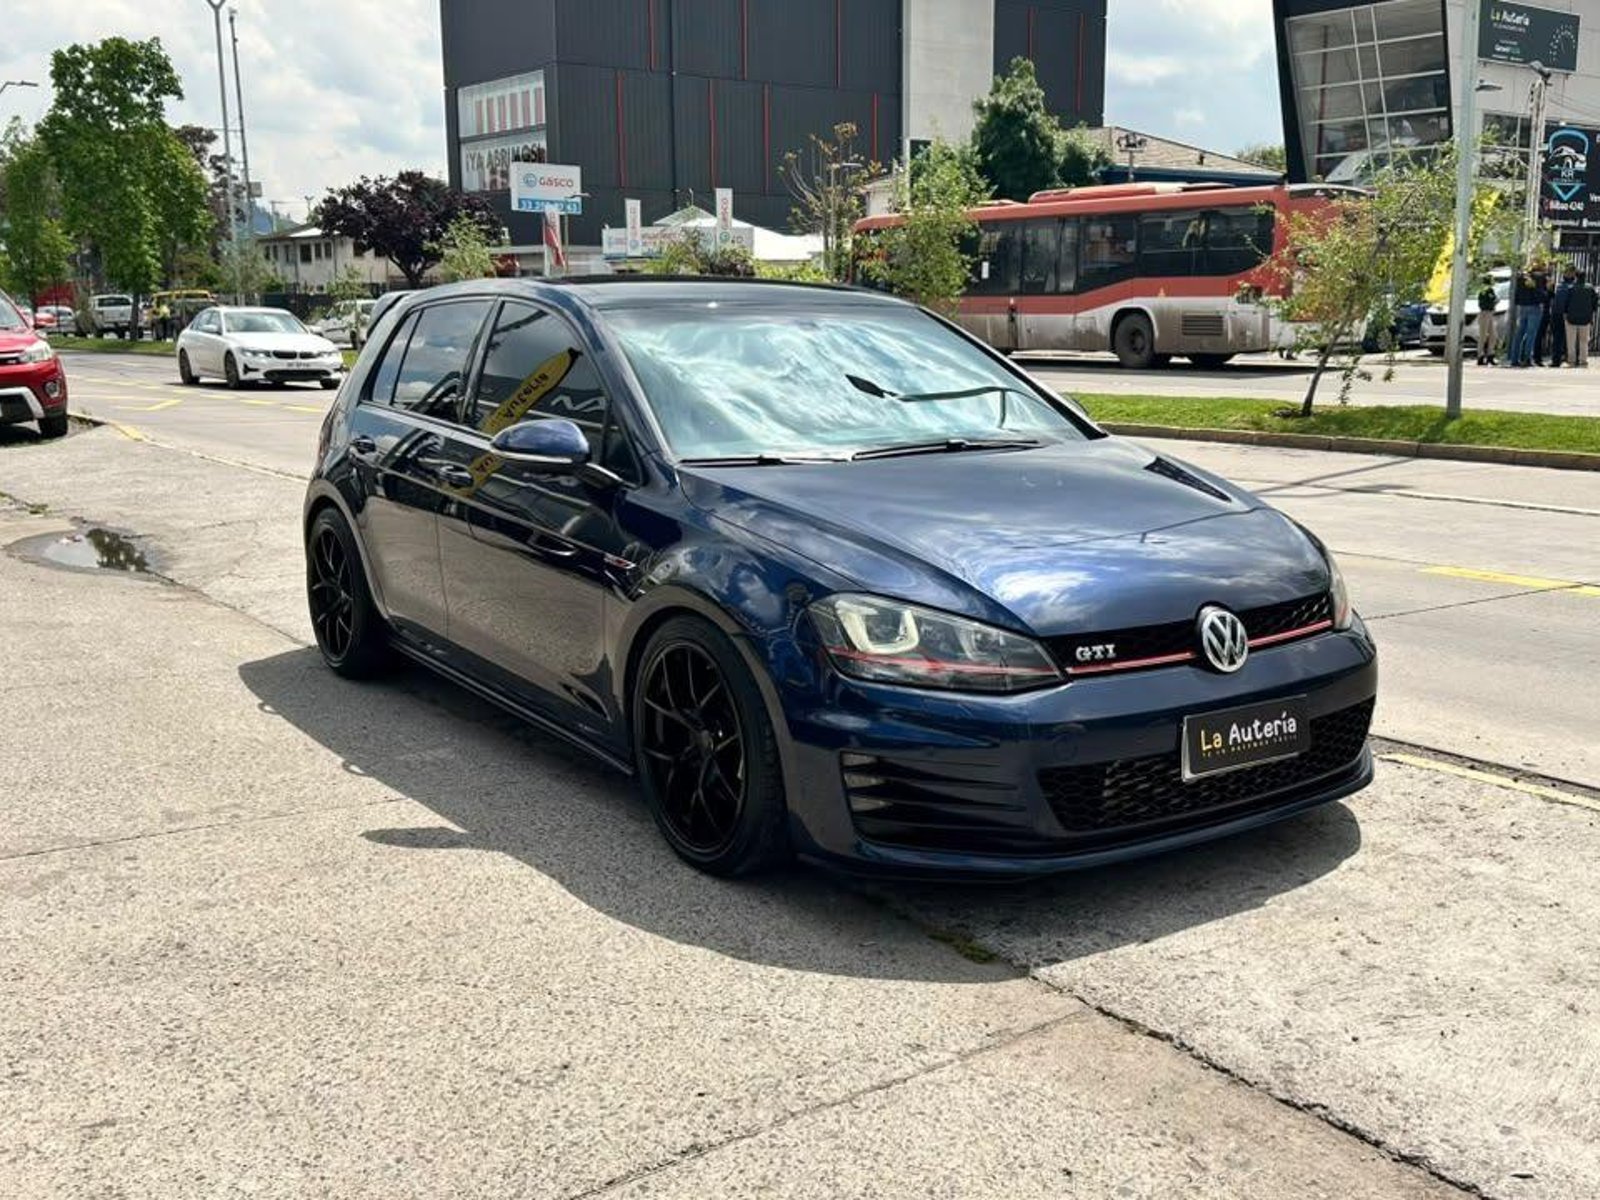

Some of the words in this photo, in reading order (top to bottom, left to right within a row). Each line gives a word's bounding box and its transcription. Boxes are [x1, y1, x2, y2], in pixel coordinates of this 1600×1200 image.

[1076, 644, 1117, 661] GTI
[1200, 730, 1223, 751] La
[1229, 710, 1297, 746] Autería
